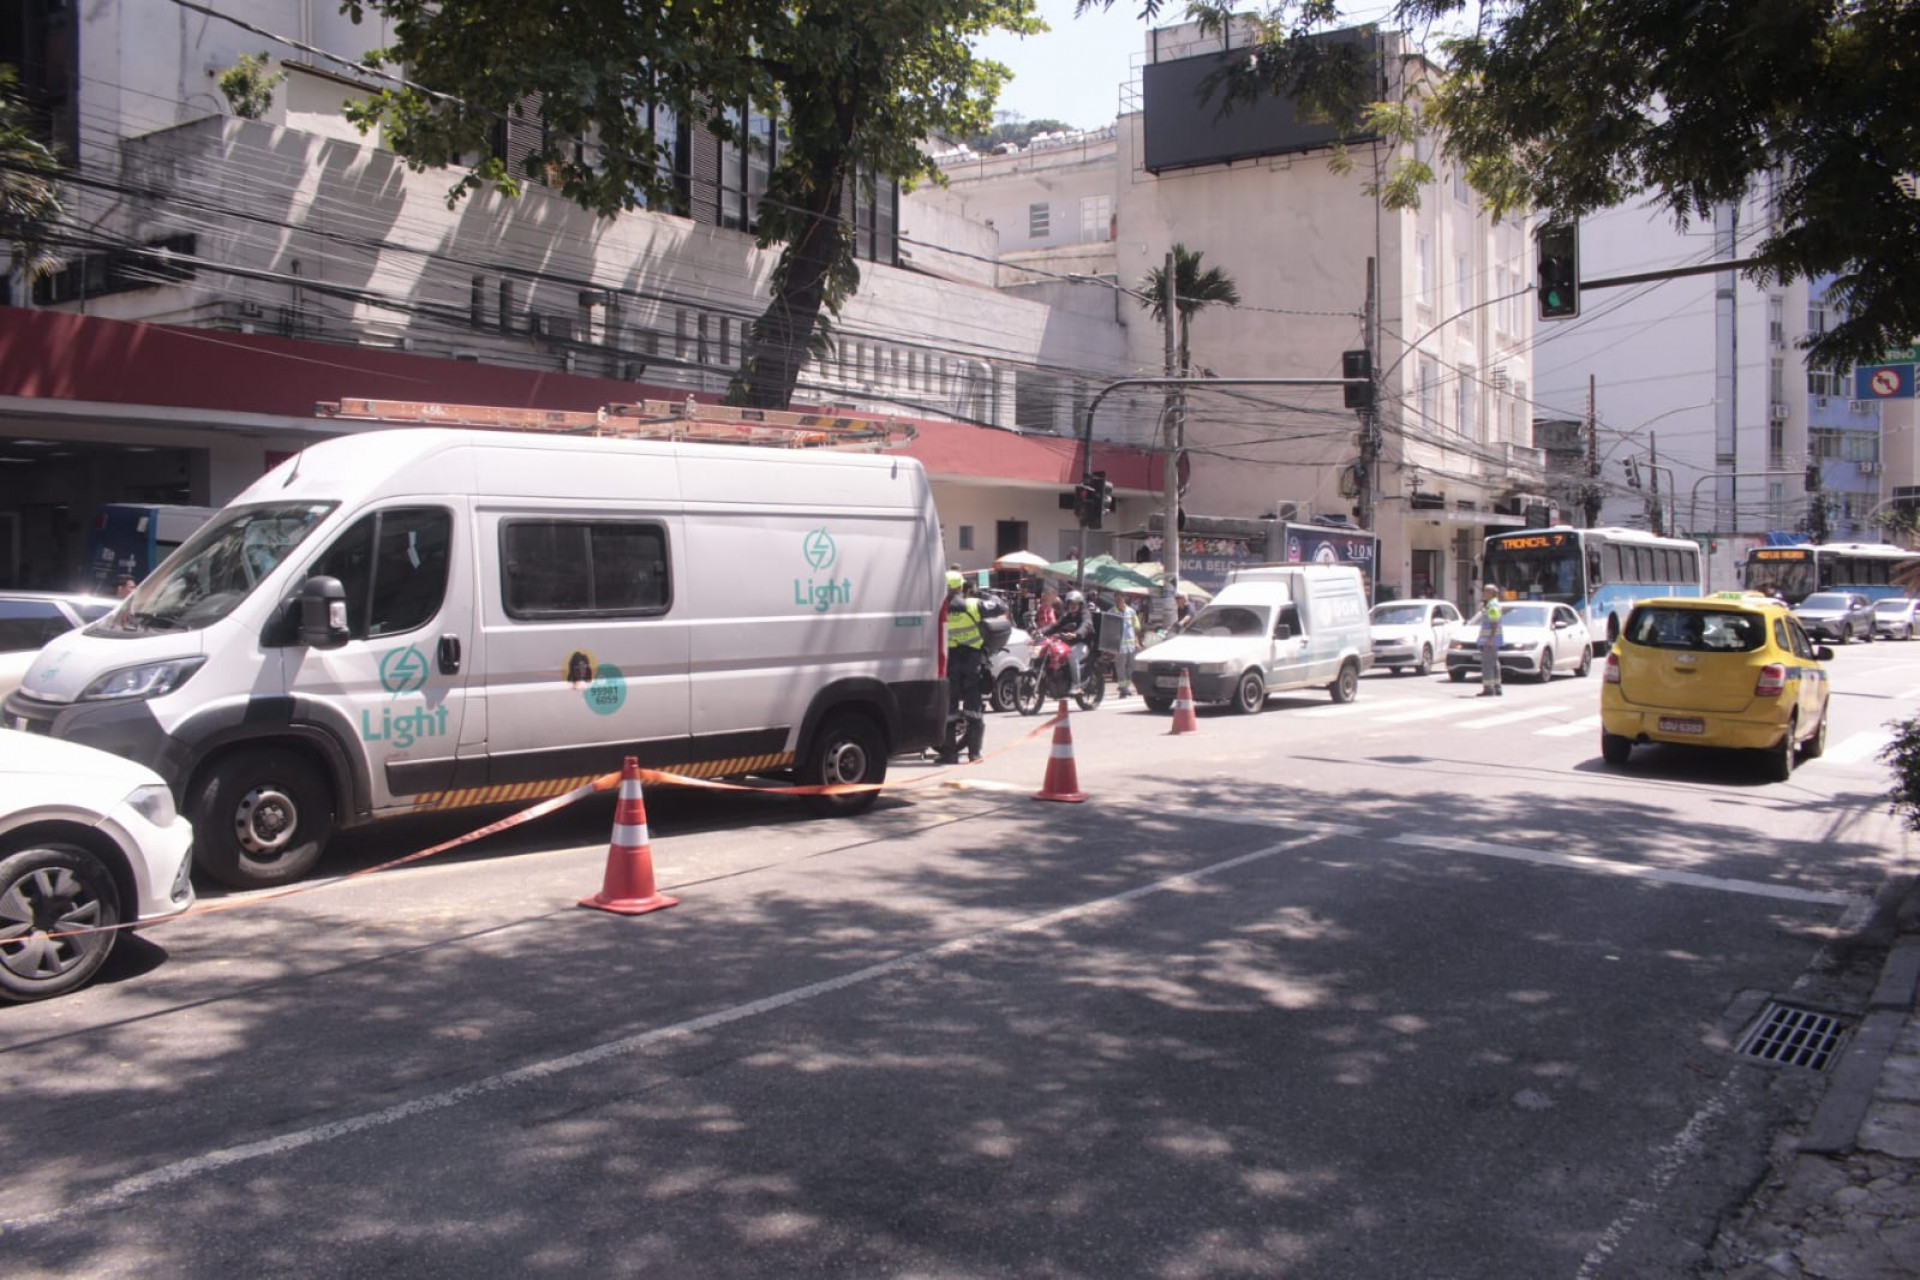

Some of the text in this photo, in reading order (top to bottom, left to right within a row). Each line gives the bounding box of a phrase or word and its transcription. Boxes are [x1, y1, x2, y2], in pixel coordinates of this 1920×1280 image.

[1554, 534, 1563, 546] 7
[794, 578, 851, 612] Light
[362, 705, 448, 748] Light
